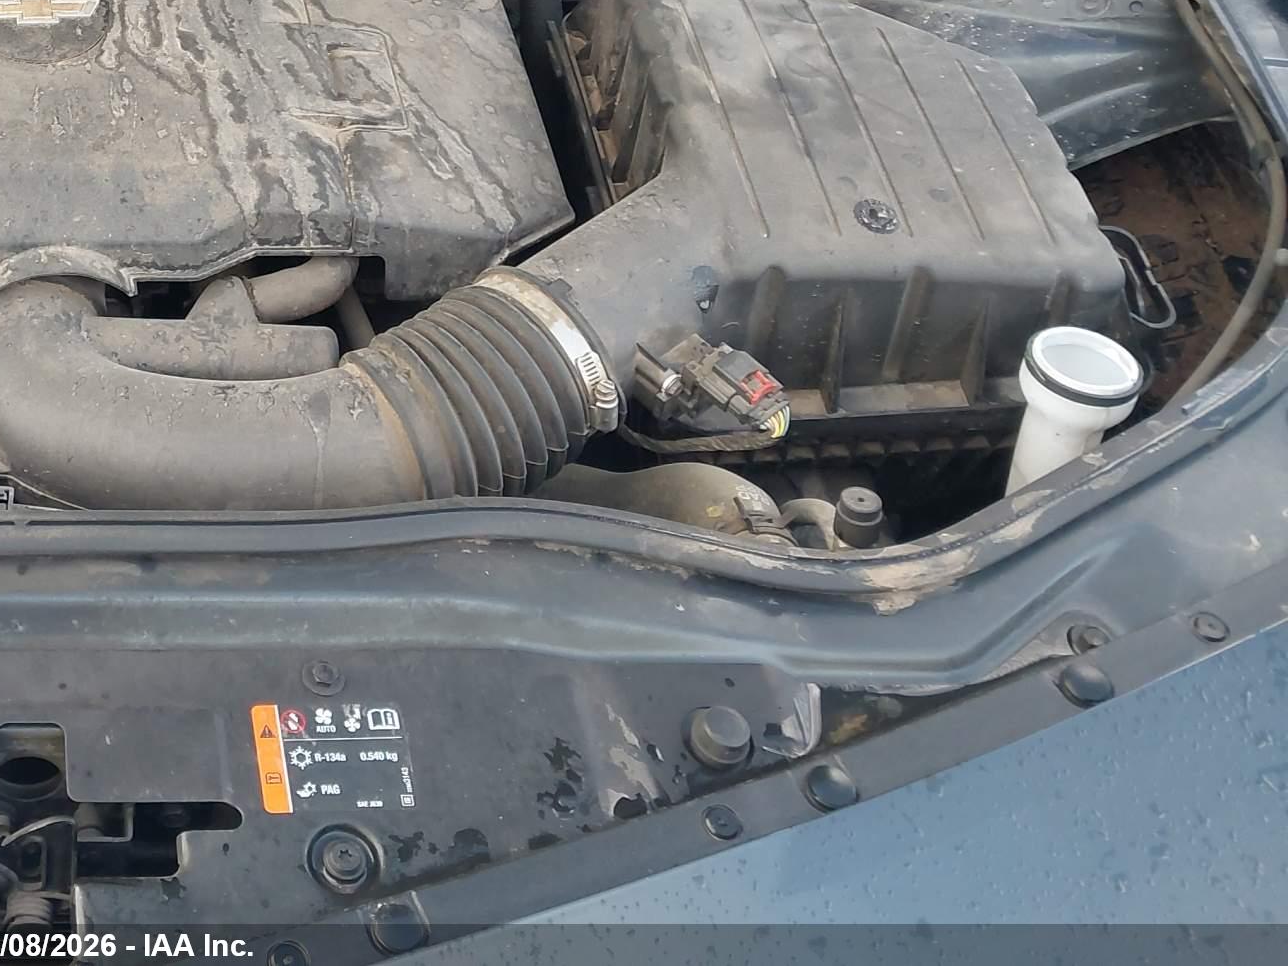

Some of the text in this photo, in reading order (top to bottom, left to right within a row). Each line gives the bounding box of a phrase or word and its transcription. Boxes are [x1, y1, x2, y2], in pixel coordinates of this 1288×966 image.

[315, 725, 337, 733] AUTO
[314, 750, 399, 764] R-134a 0.540 kg
[320, 784, 342, 795] PAG
